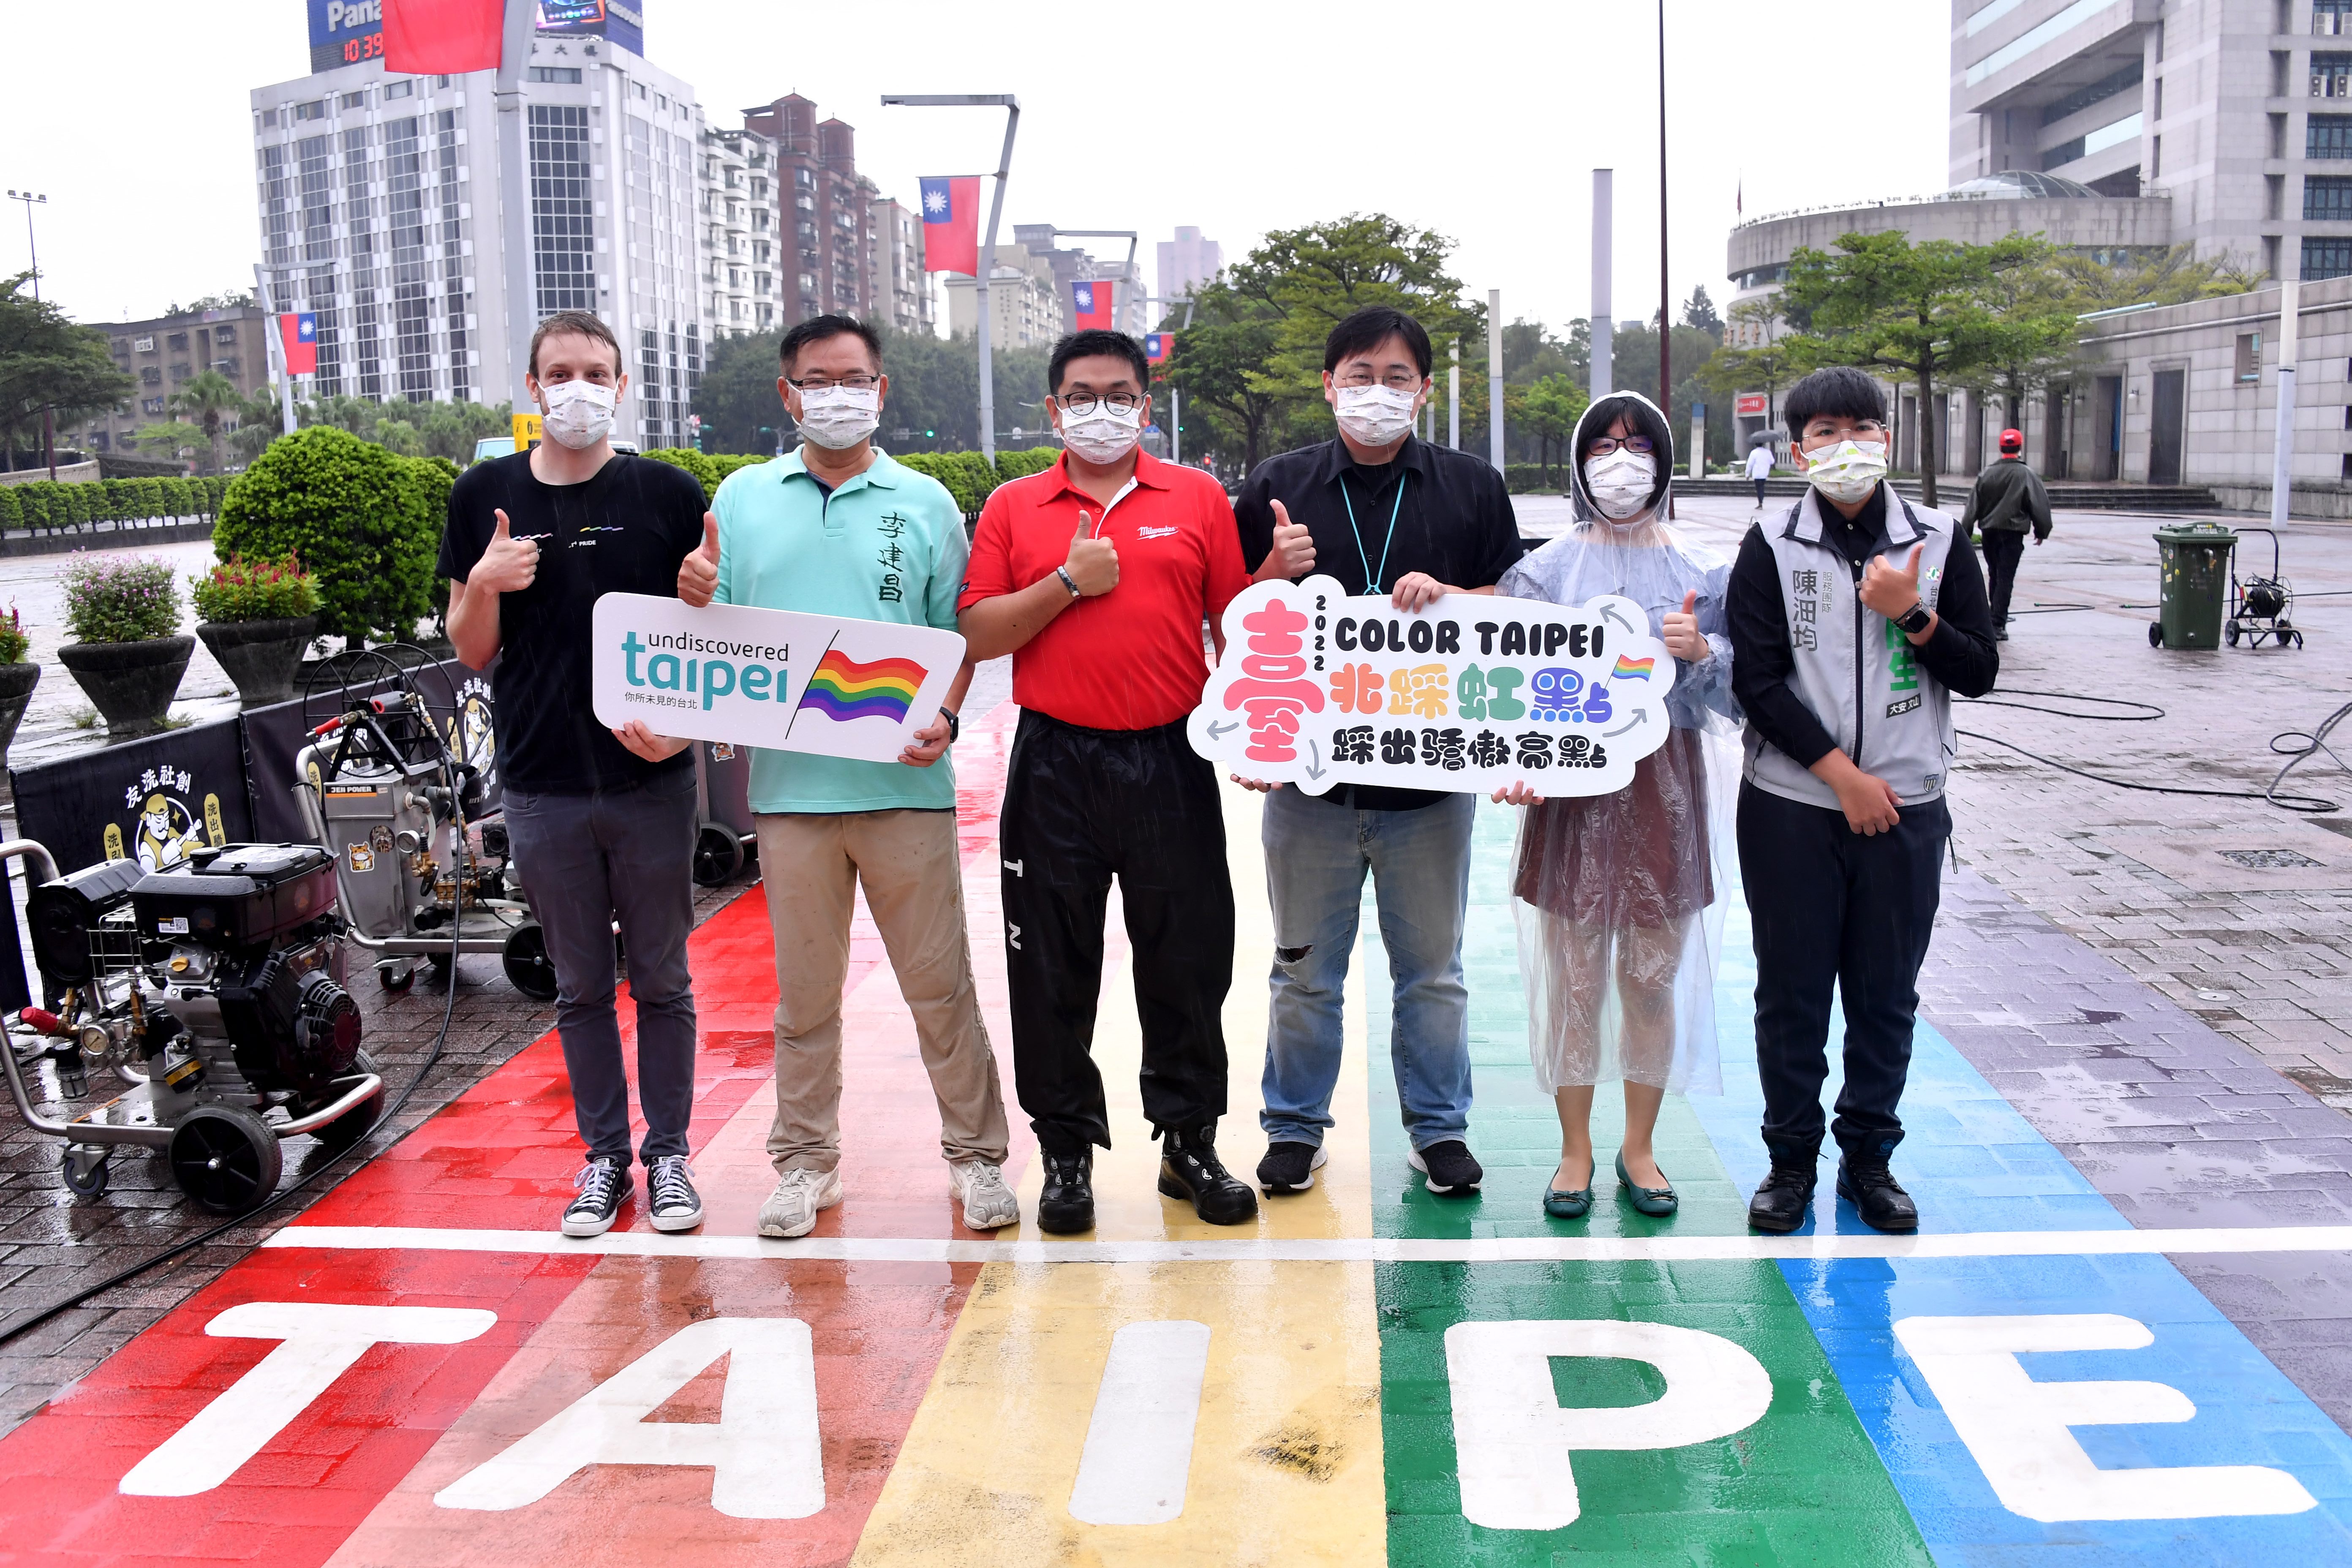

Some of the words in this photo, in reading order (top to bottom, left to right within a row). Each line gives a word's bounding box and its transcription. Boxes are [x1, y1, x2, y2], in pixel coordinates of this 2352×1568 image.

[1137, 525, 1179, 536] Milwaukee
[877, 511, 906, 603] 李建昌
[1821, 572, 1832, 613] 服務團隊
[649, 631, 789, 662] undiscovered
[1314, 595, 1326, 671] 2022
[1335, 617, 1460, 654] COLOR
[1474, 621, 1603, 658] TAIPEI
[621, 632, 787, 710] taipei
[625, 691, 697, 709] 你所未見的台北
[1331, 725, 1607, 771] 踩出驕傲亮點
[126, 765, 191, 809] 友洗社創
